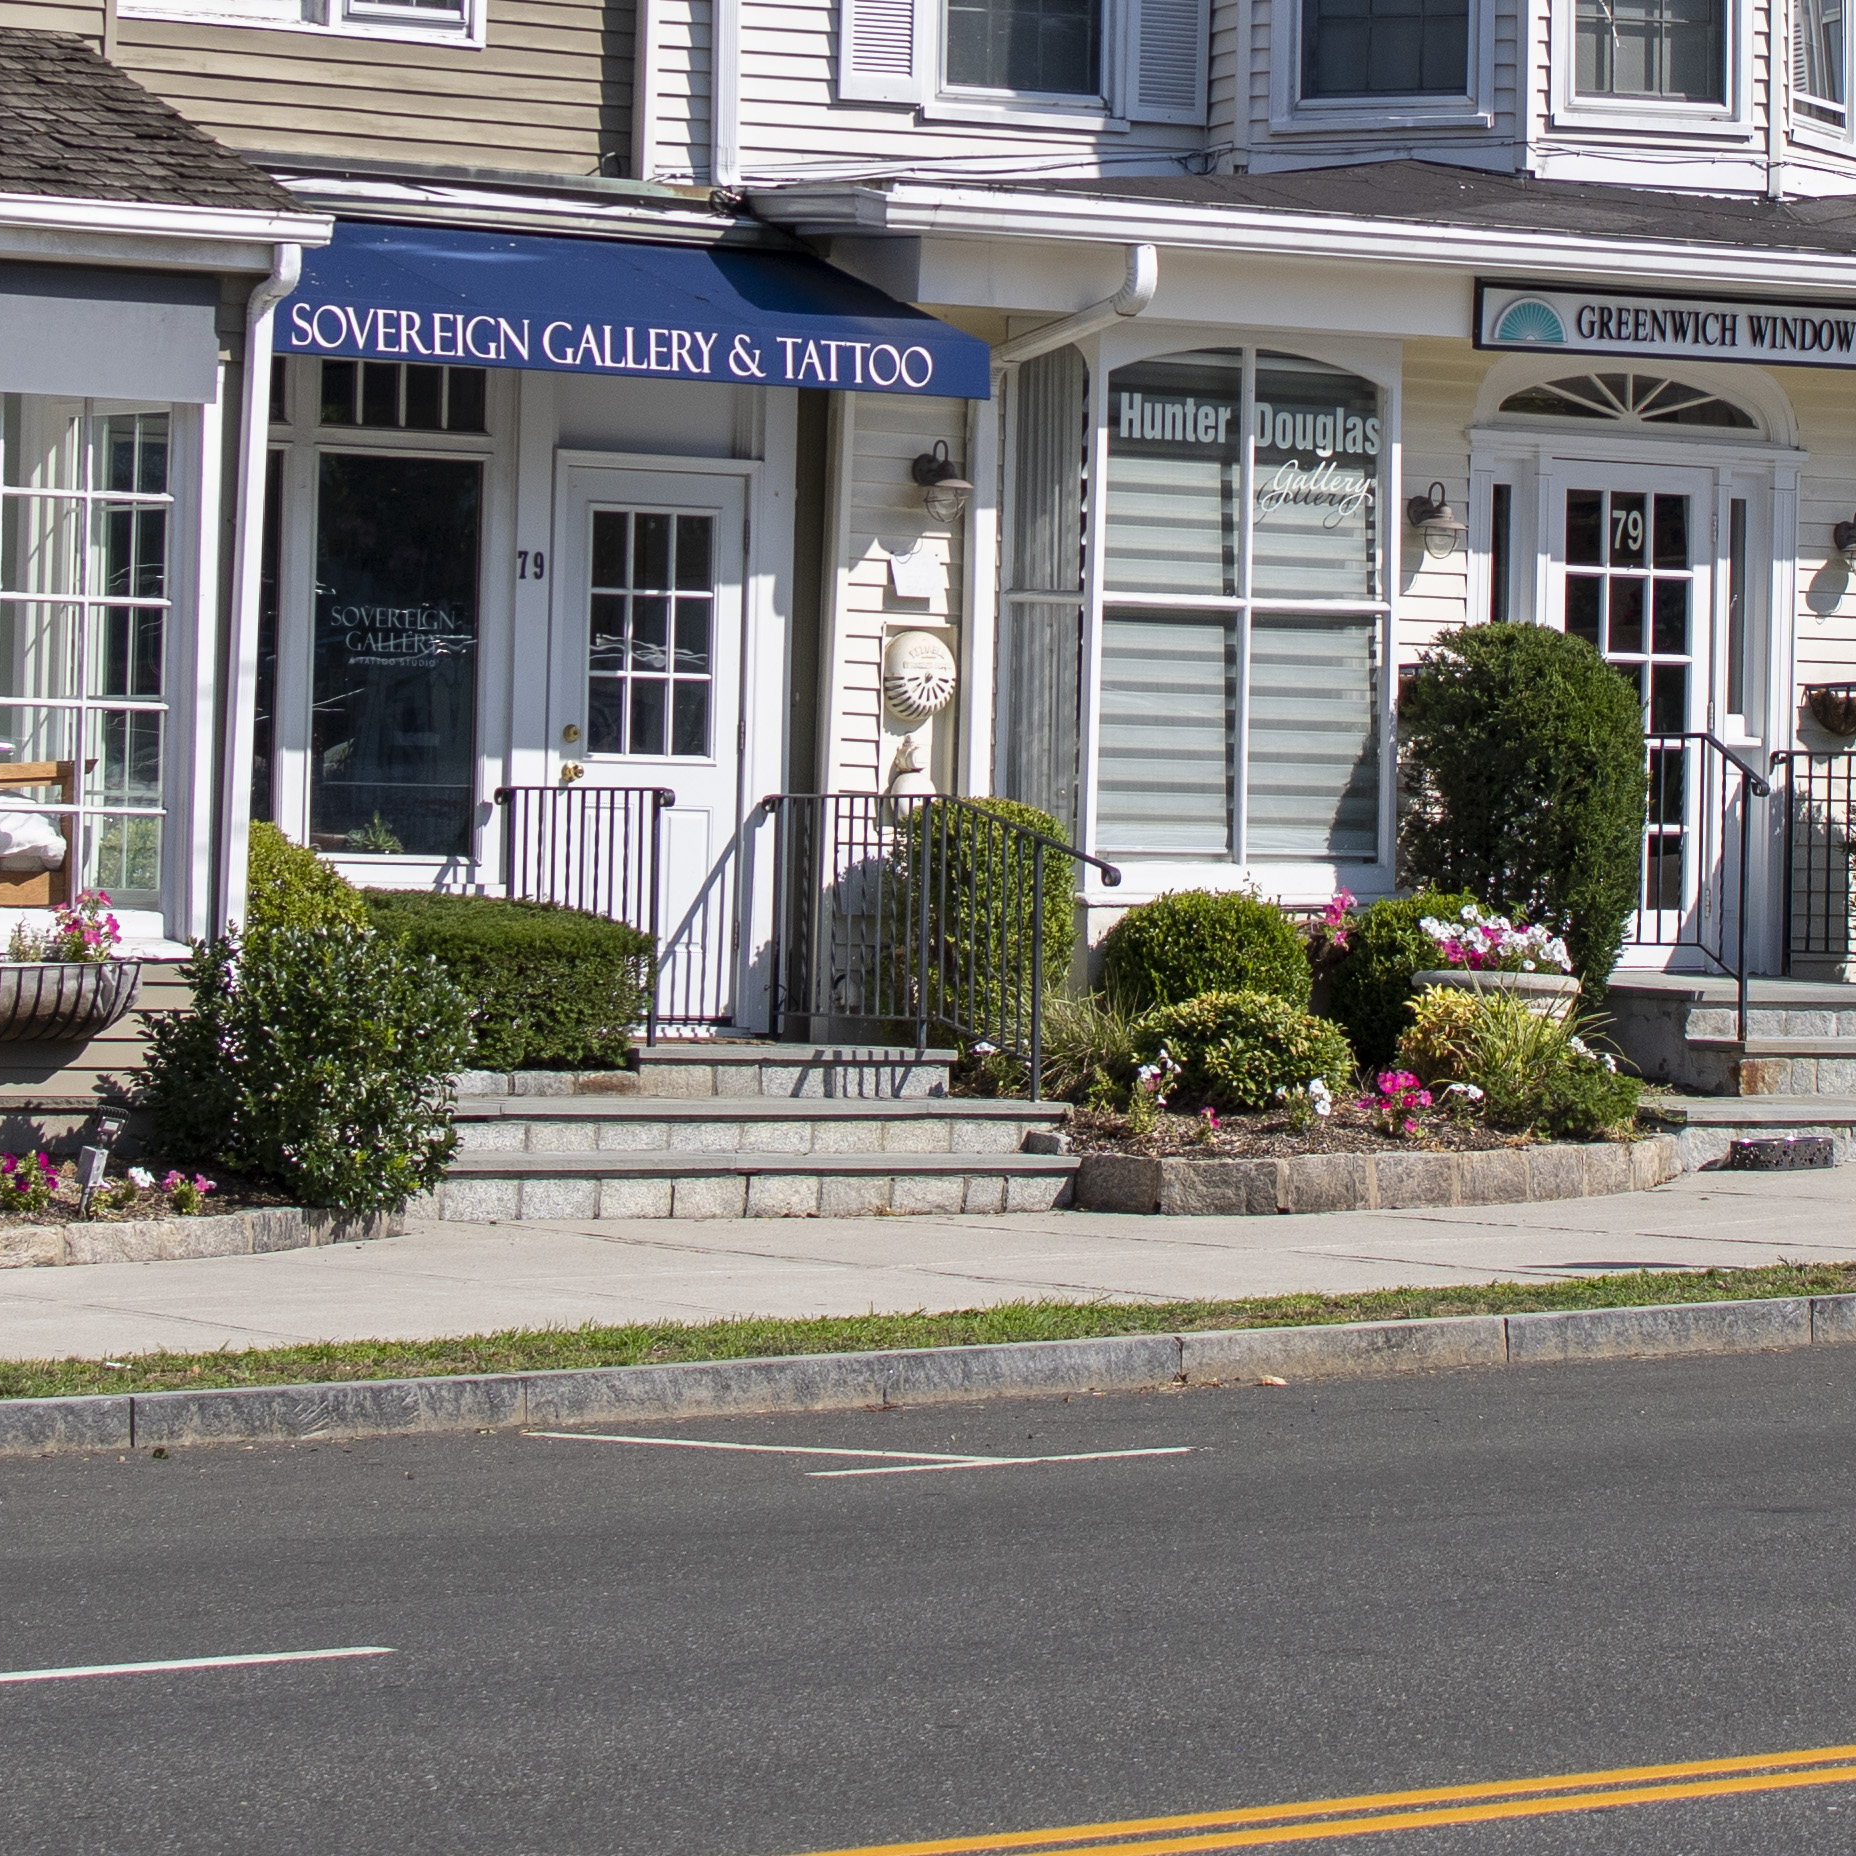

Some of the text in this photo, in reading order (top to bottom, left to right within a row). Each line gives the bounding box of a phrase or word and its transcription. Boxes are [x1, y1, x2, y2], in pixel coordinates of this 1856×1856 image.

[291, 302, 934, 388] SOVEREIGN GALLERY & TATTOO
[1576, 304, 1740, 347] GREENWICH
[1748, 314, 1856, 354] WINDOW
[1119, 391, 1381, 458] Hunter Douglas
[1261, 459, 1373, 516] Gallery
[1612, 509, 1643, 551] 79
[517, 550, 545, 580] 79
[330, 605, 455, 630] SOVEREIGN
[359, 657, 395, 666] TATTOO
[400, 658, 436, 668] STUDIO
